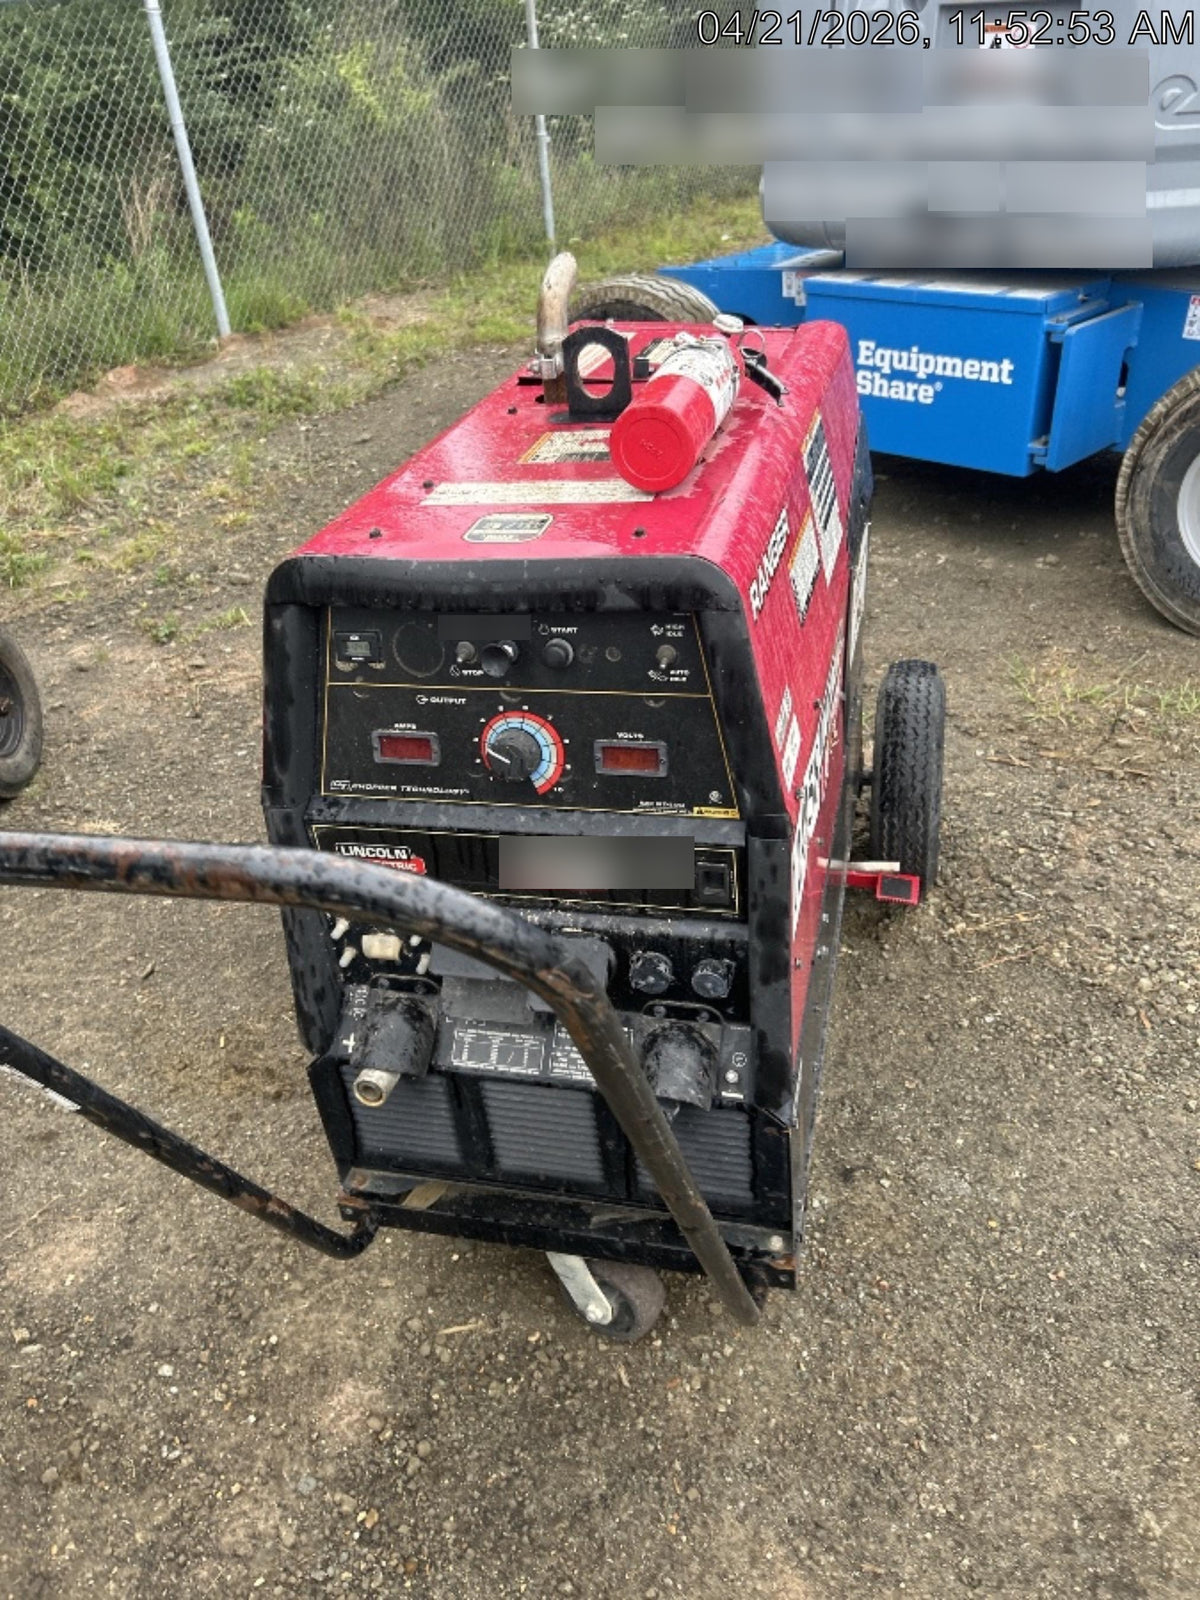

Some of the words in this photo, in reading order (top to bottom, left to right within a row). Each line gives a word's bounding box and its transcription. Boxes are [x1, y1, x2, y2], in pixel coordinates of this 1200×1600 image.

[856, 340, 1014, 384] Equipment
[550, 626, 579, 634] START
[429, 696, 467, 705] OUTPUT
[340, 845, 408, 860] LINCOLN
